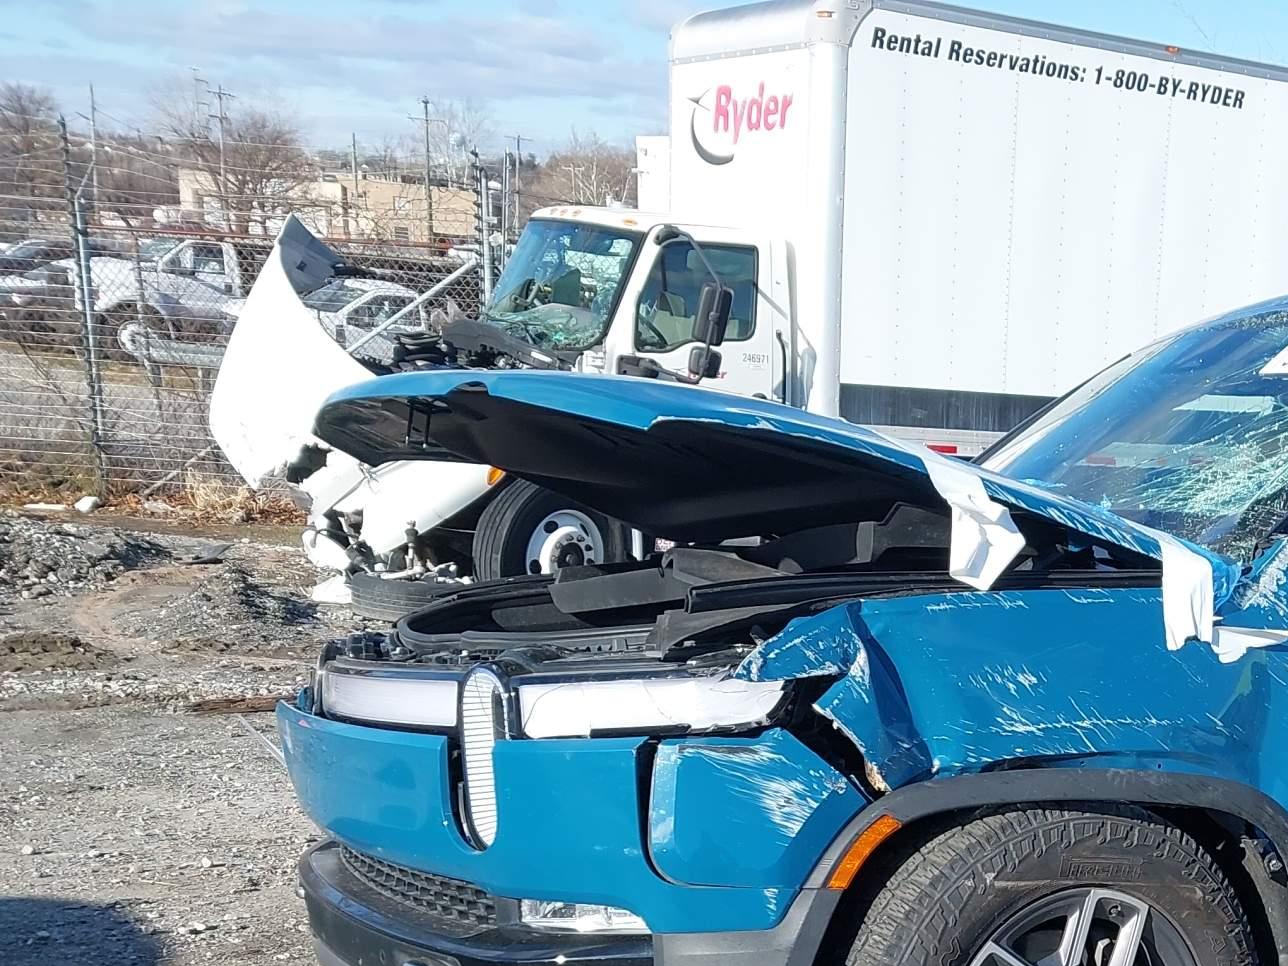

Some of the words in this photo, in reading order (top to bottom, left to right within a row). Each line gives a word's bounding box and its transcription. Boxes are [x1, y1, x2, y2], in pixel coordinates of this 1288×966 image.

[871, 26, 942, 60] Rental
[947, 39, 1087, 83] Reservations:
[1094, 65, 1246, 110] 1-800-BY-RYDER
[713, 80, 794, 145] Ryder
